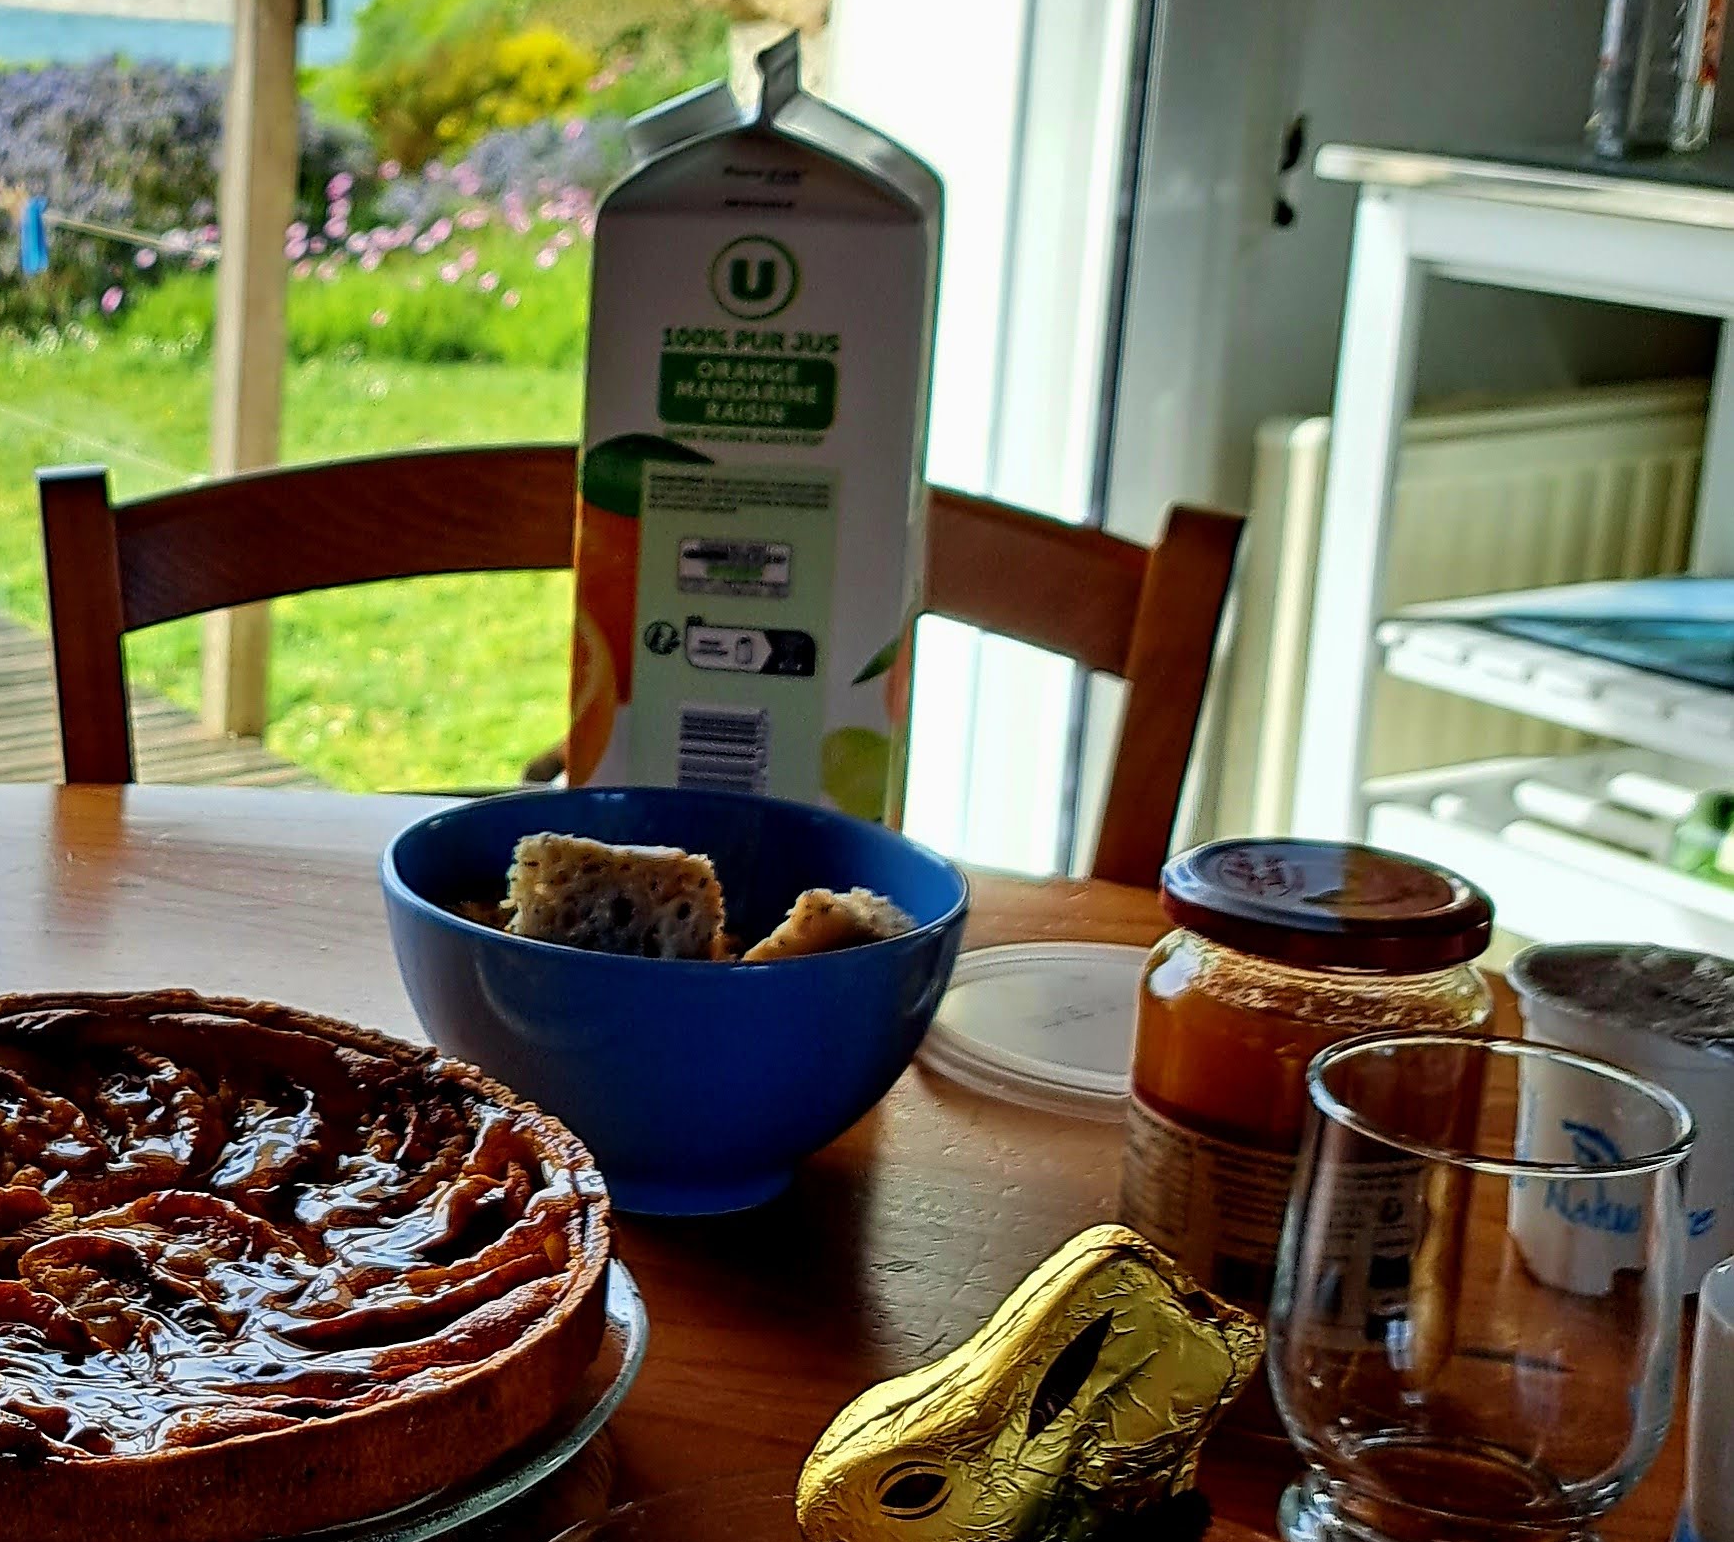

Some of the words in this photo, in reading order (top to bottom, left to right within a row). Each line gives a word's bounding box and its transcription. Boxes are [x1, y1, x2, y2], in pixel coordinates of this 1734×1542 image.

[730, 258, 776, 301] U
[663, 326, 727, 348] 100%
[733, 330, 784, 350] PUR
[791, 331, 842, 354] JUS
[696, 361, 800, 381] ORANGE
[674, 379, 817, 404] MANDARINE
[702, 402, 785, 423] RAISIN
